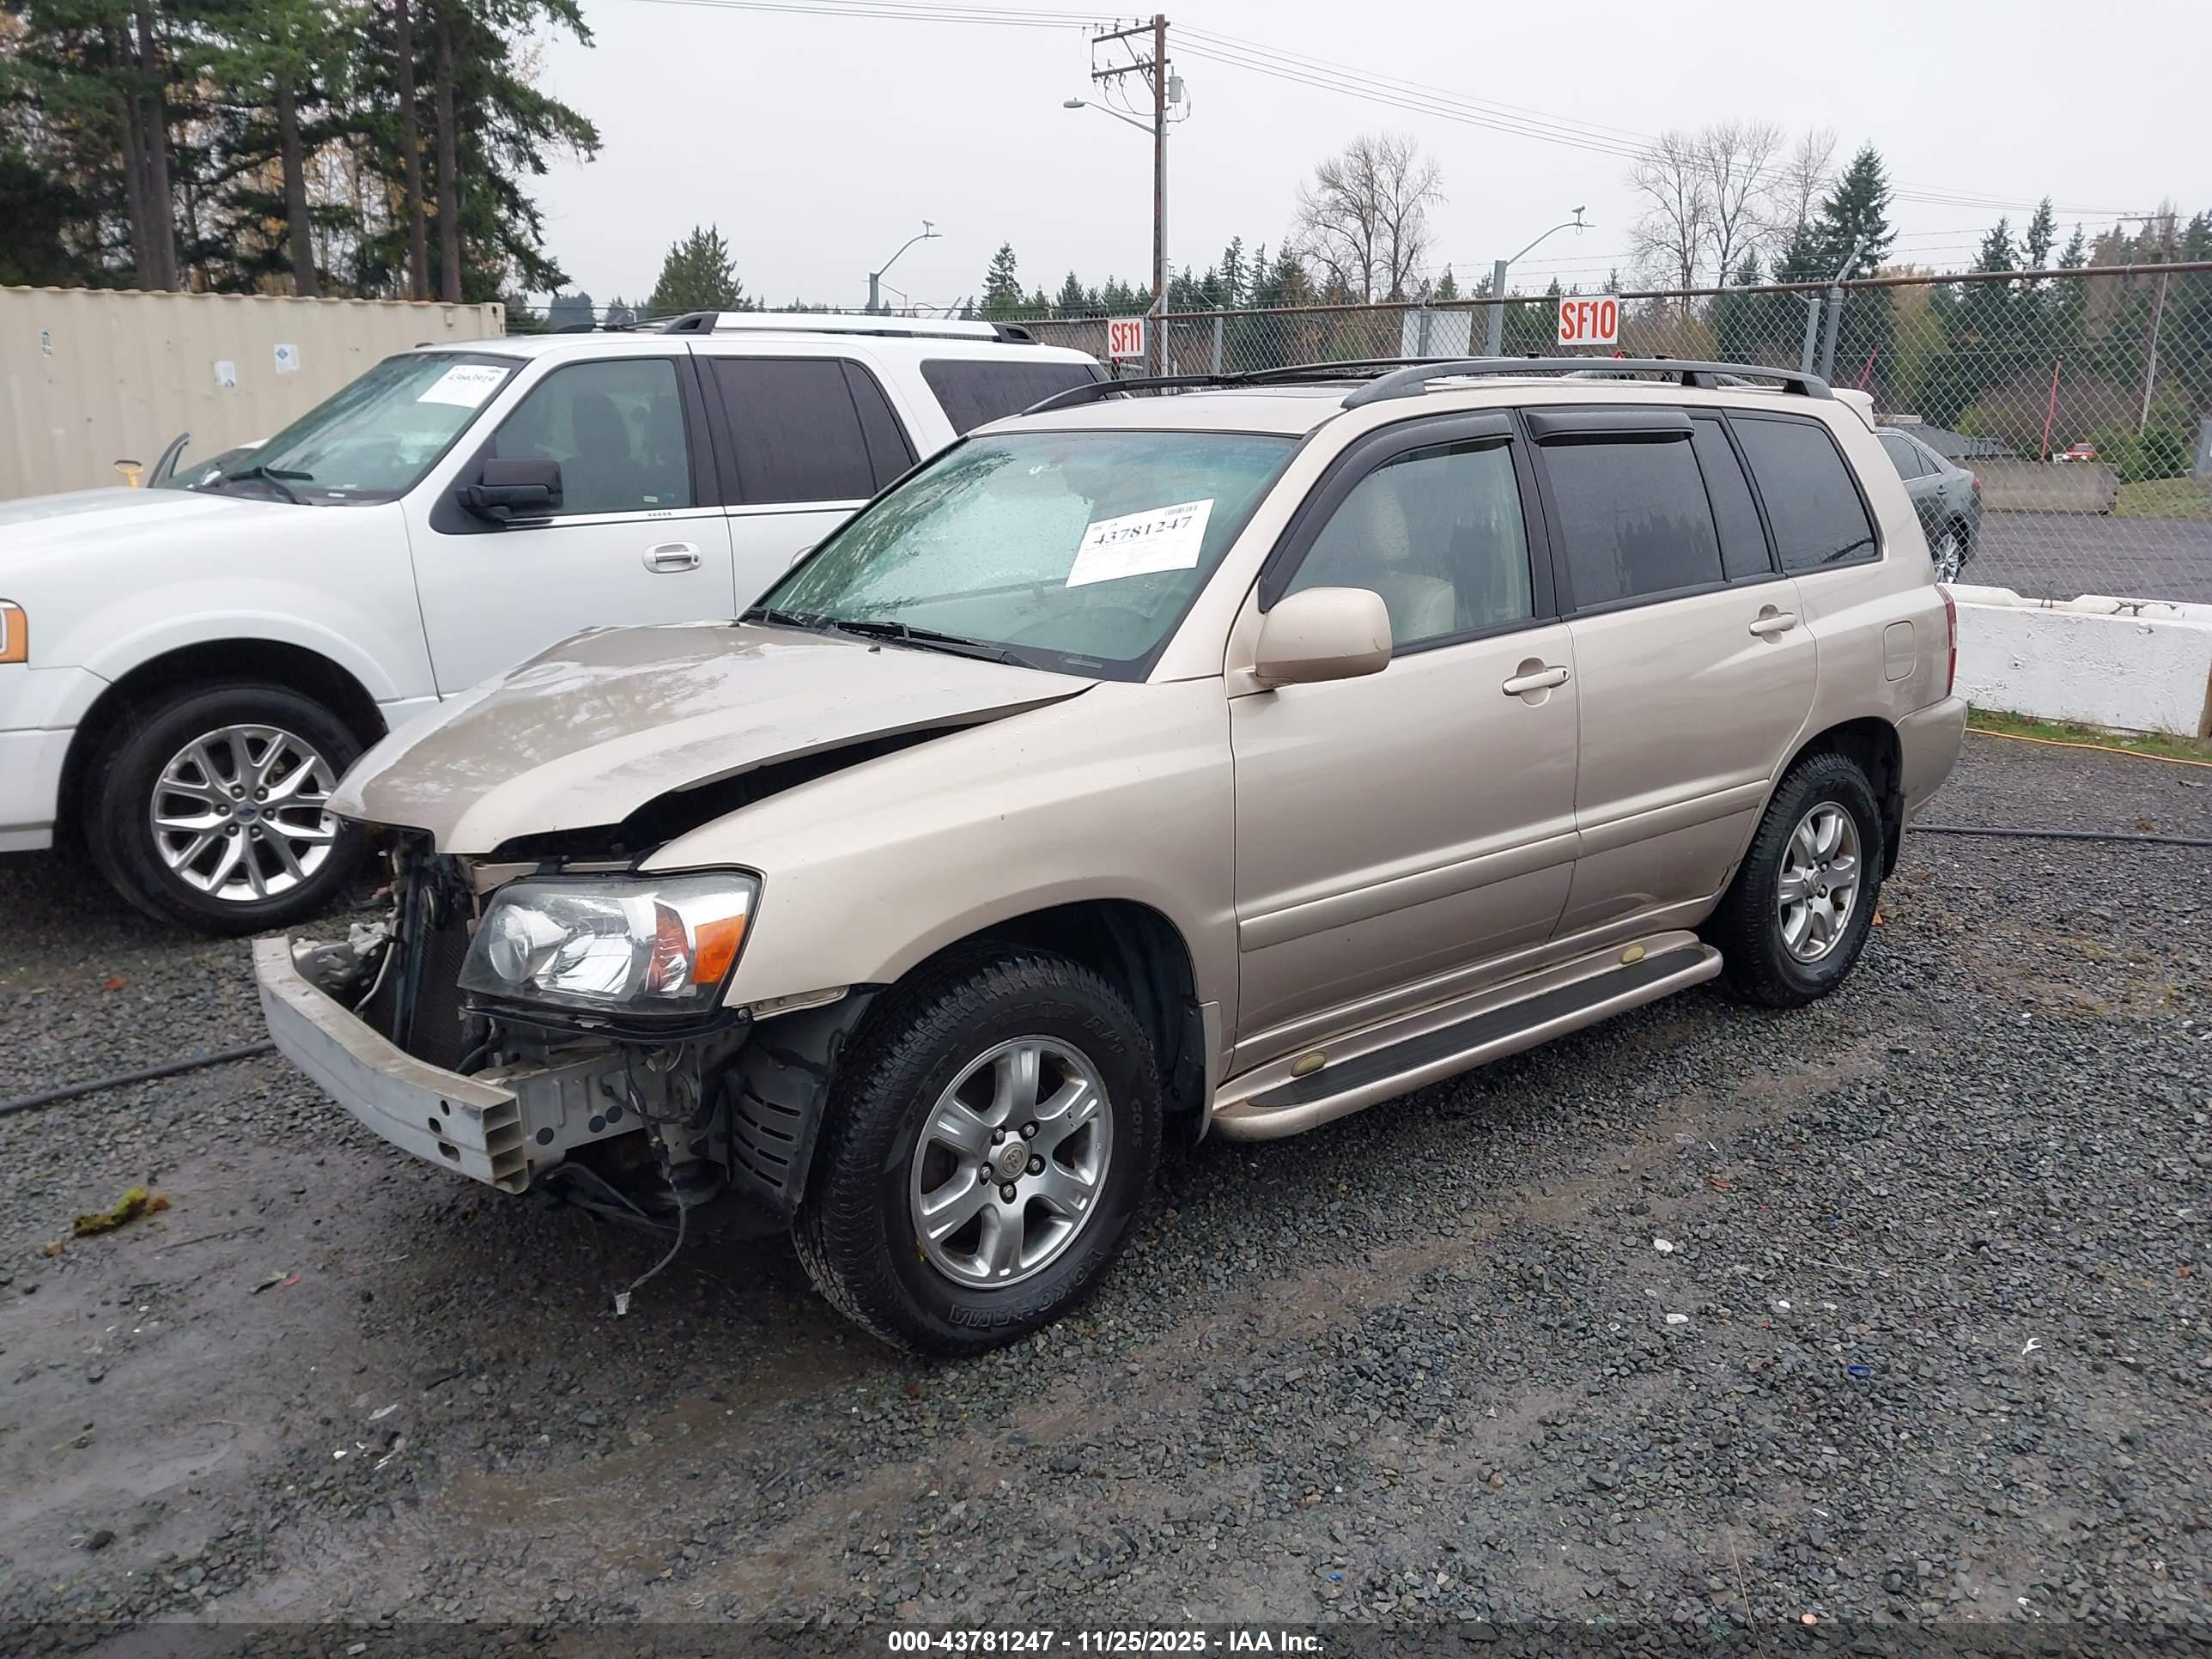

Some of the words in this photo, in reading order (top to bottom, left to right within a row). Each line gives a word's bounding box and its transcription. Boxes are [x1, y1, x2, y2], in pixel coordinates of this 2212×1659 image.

[1560, 300, 1616, 340] SF10
[1111, 322, 1141, 353] SF11
[1093, 515, 1194, 545] 43781247
